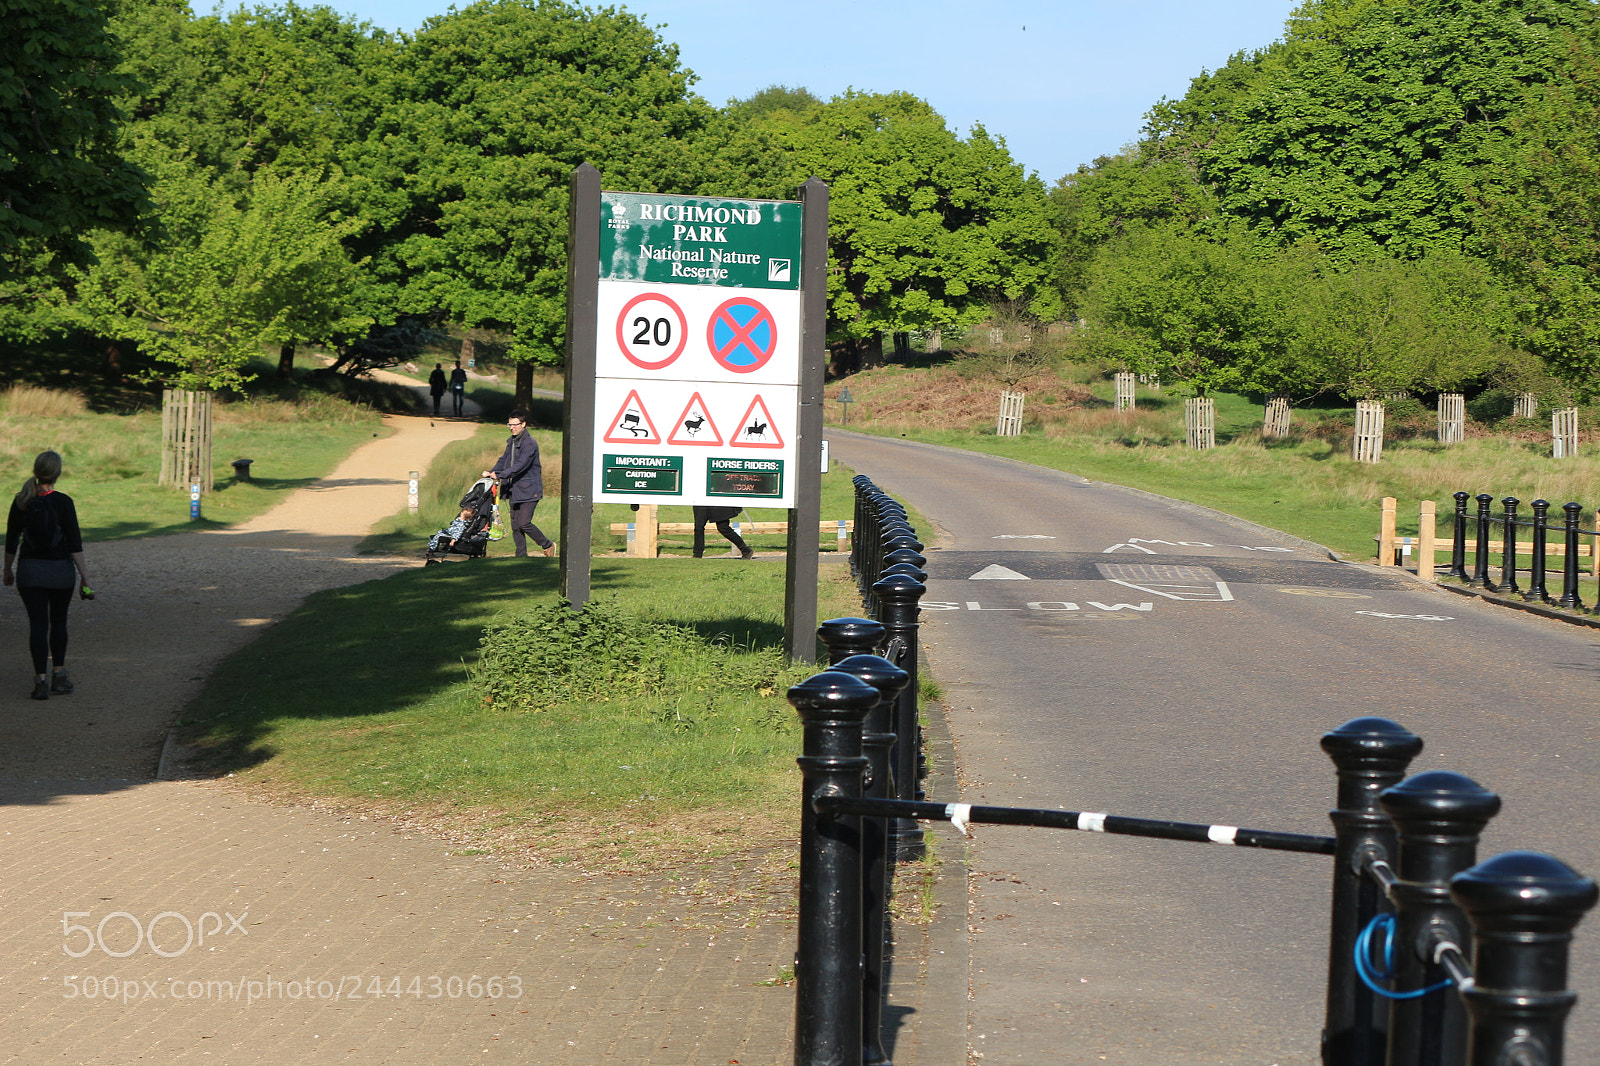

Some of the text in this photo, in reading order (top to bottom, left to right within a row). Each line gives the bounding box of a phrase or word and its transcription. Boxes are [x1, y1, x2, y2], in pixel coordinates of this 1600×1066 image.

[640, 203, 762, 226] RICHMOND
[672, 224, 728, 243] PARK
[639, 244, 761, 264] National Nature
[671, 262, 729, 279] Reserve
[632, 316, 671, 346] 20
[615, 456, 671, 467] IMPORTANT:
[711, 459, 780, 471] HORSE RIDERS:
[625, 470, 657, 479] CAUTION
[634, 480, 648, 488] ICE
[732, 483, 755, 491] TODAY
[917, 601, 1154, 611] SLOW
